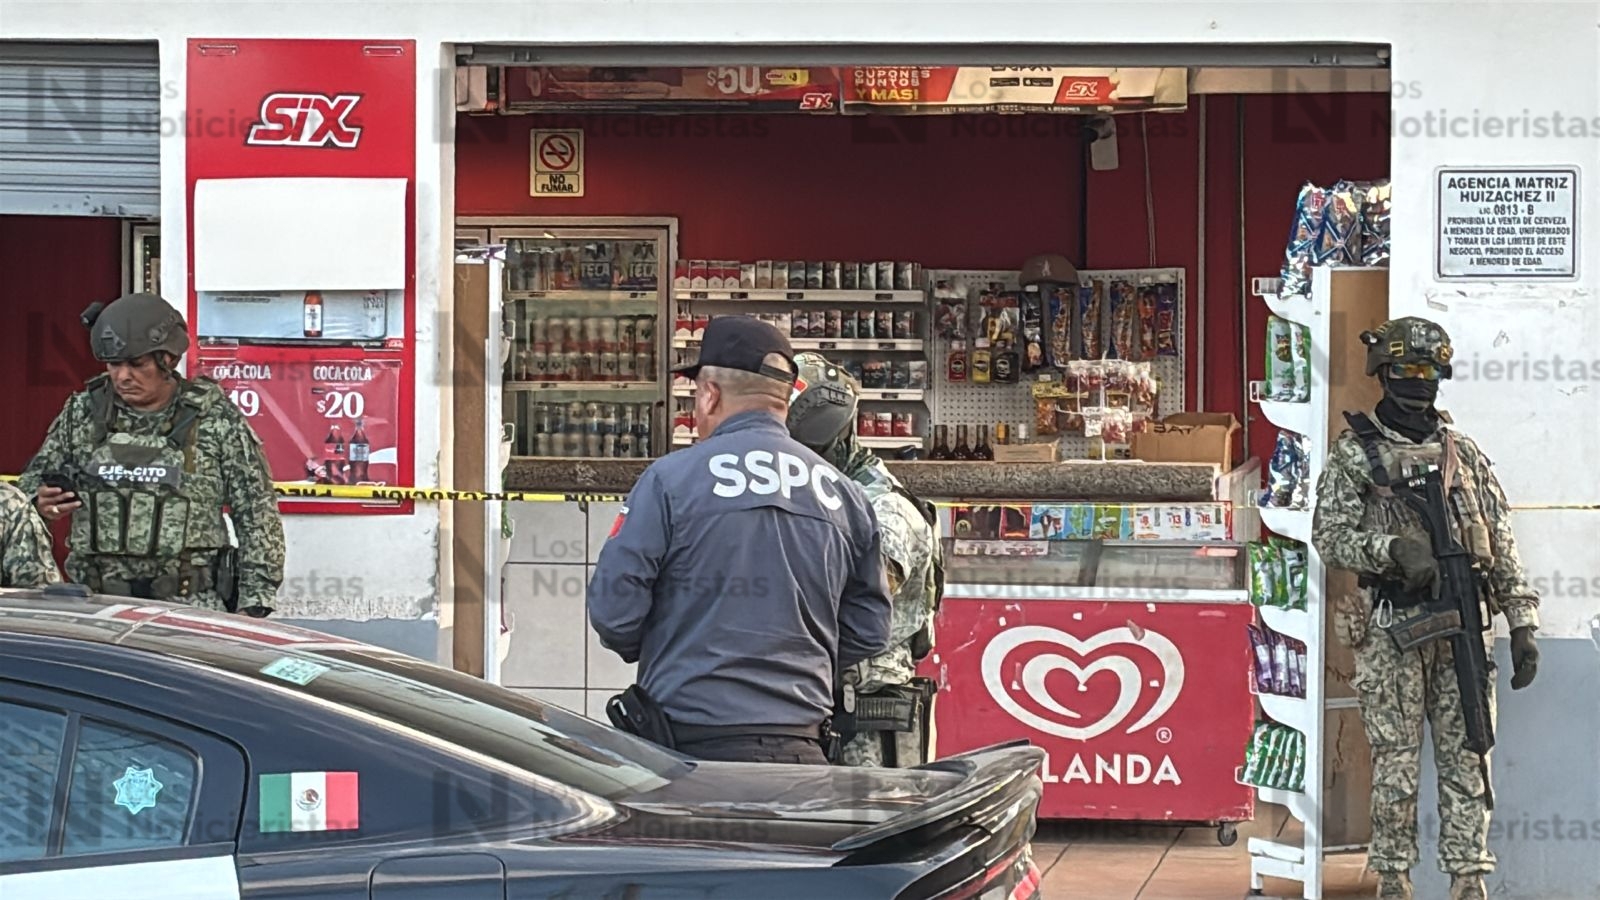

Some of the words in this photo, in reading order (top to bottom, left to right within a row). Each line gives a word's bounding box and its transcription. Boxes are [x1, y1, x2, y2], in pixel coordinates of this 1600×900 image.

[549, 174, 566, 184] NO
[1448, 177, 1511, 189] AGENCIA
[1515, 177, 1568, 189] MATRIZ
[541, 183, 574, 192] FUMAR
[1460, 191, 1542, 202] HUIZACHEZ
[1546, 191, 1555, 202] II
[1494, 204, 1518, 216] 0813
[1527, 204, 1534, 215] B
[1447, 217, 1486, 225] PROHIBIDA
[1487, 217, 1496, 225] LA
[1498, 217, 1521, 225] VENTA
[1523, 217, 1532, 225] DE
[1534, 217, 1566, 225] CERVEZA
[1450, 227, 1484, 235] MENORES
[1486, 227, 1495, 235] DE
[1519, 227, 1570, 235] UNIFORMADOS
[1454, 237, 1479, 245] TOMAR
[1480, 237, 1490, 245] EN
[1492, 237, 1506, 245] LOS
[1537, 237, 1546, 245] DE
[1548, 237, 1566, 245] ESTE
[1484, 247, 1523, 255] PROHIBIDO
[1526, 247, 1533, 255] EL
[1536, 247, 1564, 255] ACCESO
[213, 365, 271, 380] COCA-COLA
[313, 365, 372, 381] COCA-COLA
[316, 391, 364, 418] $20
[709, 450, 842, 510] SSPC
[1042, 752, 1182, 785] LANDA
